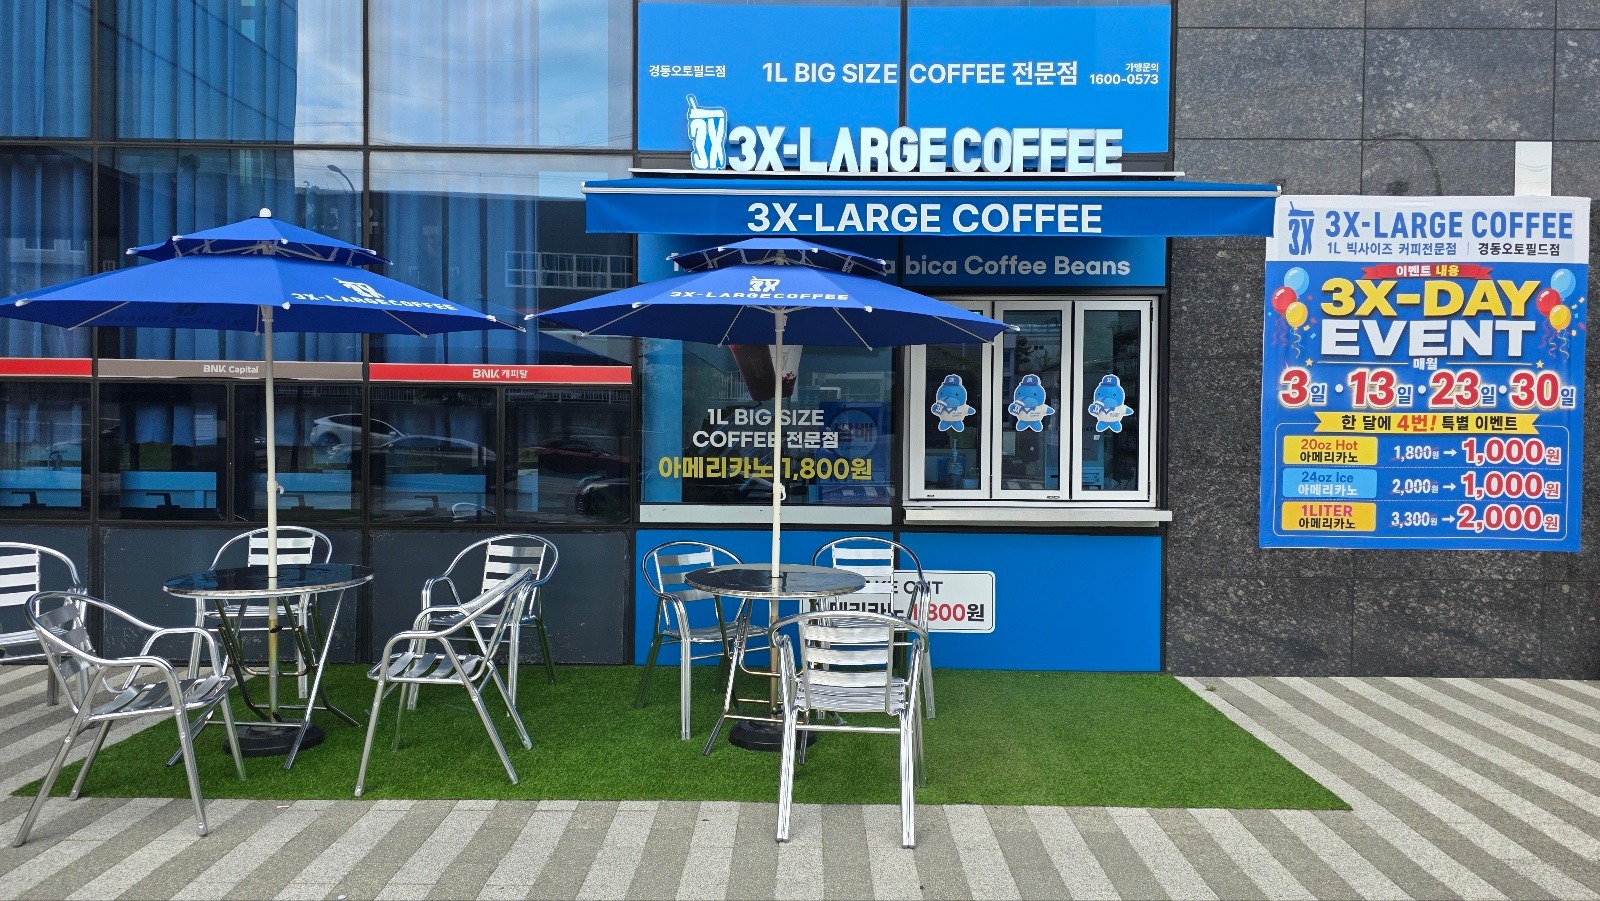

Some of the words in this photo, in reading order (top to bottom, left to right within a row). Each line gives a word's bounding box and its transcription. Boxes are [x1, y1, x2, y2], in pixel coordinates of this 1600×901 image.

[649, 65, 726, 78] 경동오토필드점
[762, 62, 787, 82] 1L
[794, 62, 835, 83] BIG
[842, 63, 897, 84] SIZE
[909, 63, 1005, 84] COFFEE
[1012, 61, 1077, 86] 전문점
[1125, 62, 1159, 73] 가맹문의
[1089, 74, 1159, 85] 1600-0573
[728, 126, 946, 173] 3X-LARGE
[952, 127, 1122, 173] COFFEE
[747, 203, 940, 233] 3X-LARGE
[952, 203, 1102, 234] COFFEE
[1325, 210, 1463, 239] 3X-LARGE
[1472, 211, 1573, 239] COFFEE
[1327, 242, 1341, 254] 1L
[1347, 242, 1393, 256] 빅사이즈
[1398, 242, 1457, 256] 커피전문점
[1478, 242, 1560, 257] 경동오토필드점
[964, 255, 1047, 275] Coffee
[1054, 256, 1130, 275] Beans
[1396, 264, 1431, 277] 이벤트
[1435, 264, 1460, 277] 내용
[1320, 277, 1540, 318] 3X-DAY
[1320, 318, 1536, 358] EVENT
[203, 364, 227, 374] BNK
[228, 365, 259, 375] Capital
[1412, 357, 1438, 370] 매월
[472, 368, 500, 379] BNK
[707, 409, 729, 425] 1L
[735, 409, 772, 426] BIG
[780, 410, 825, 426] SIZE
[1341, 414, 1357, 431] 한
[1362, 415, 1391, 431] 달에
[1396, 415, 1437, 432] 4번!
[1442, 415, 1469, 431] 특별
[1475, 415, 1518, 431] 이벤트
[692, 430, 776, 448] COFFEE
[786, 431, 839, 449] 전문점
[1301, 438, 1332, 451] 20oz
[1336, 439, 1359, 451] Hot
[1300, 451, 1359, 463] 아메리카노
[1394, 445, 1440, 462] 1,800원
[1462, 437, 1561, 465] 1,000원
[658, 456, 774, 479] 아메리카노
[782, 457, 872, 480] 1,800원
[1301, 471, 1333, 483] 24oz
[1336, 471, 1354, 483] Ice
[1392, 478, 1439, 496] 2,000원
[1461, 471, 1561, 499] 1,000원
[1297, 484, 1358, 497] 아메리카노
[1301, 504, 1353, 518] 1LITER
[1391, 511, 1438, 528] 3,300원
[1457, 504, 1560, 532] 2,000원
[1298, 518, 1356, 530] 아메리카노
